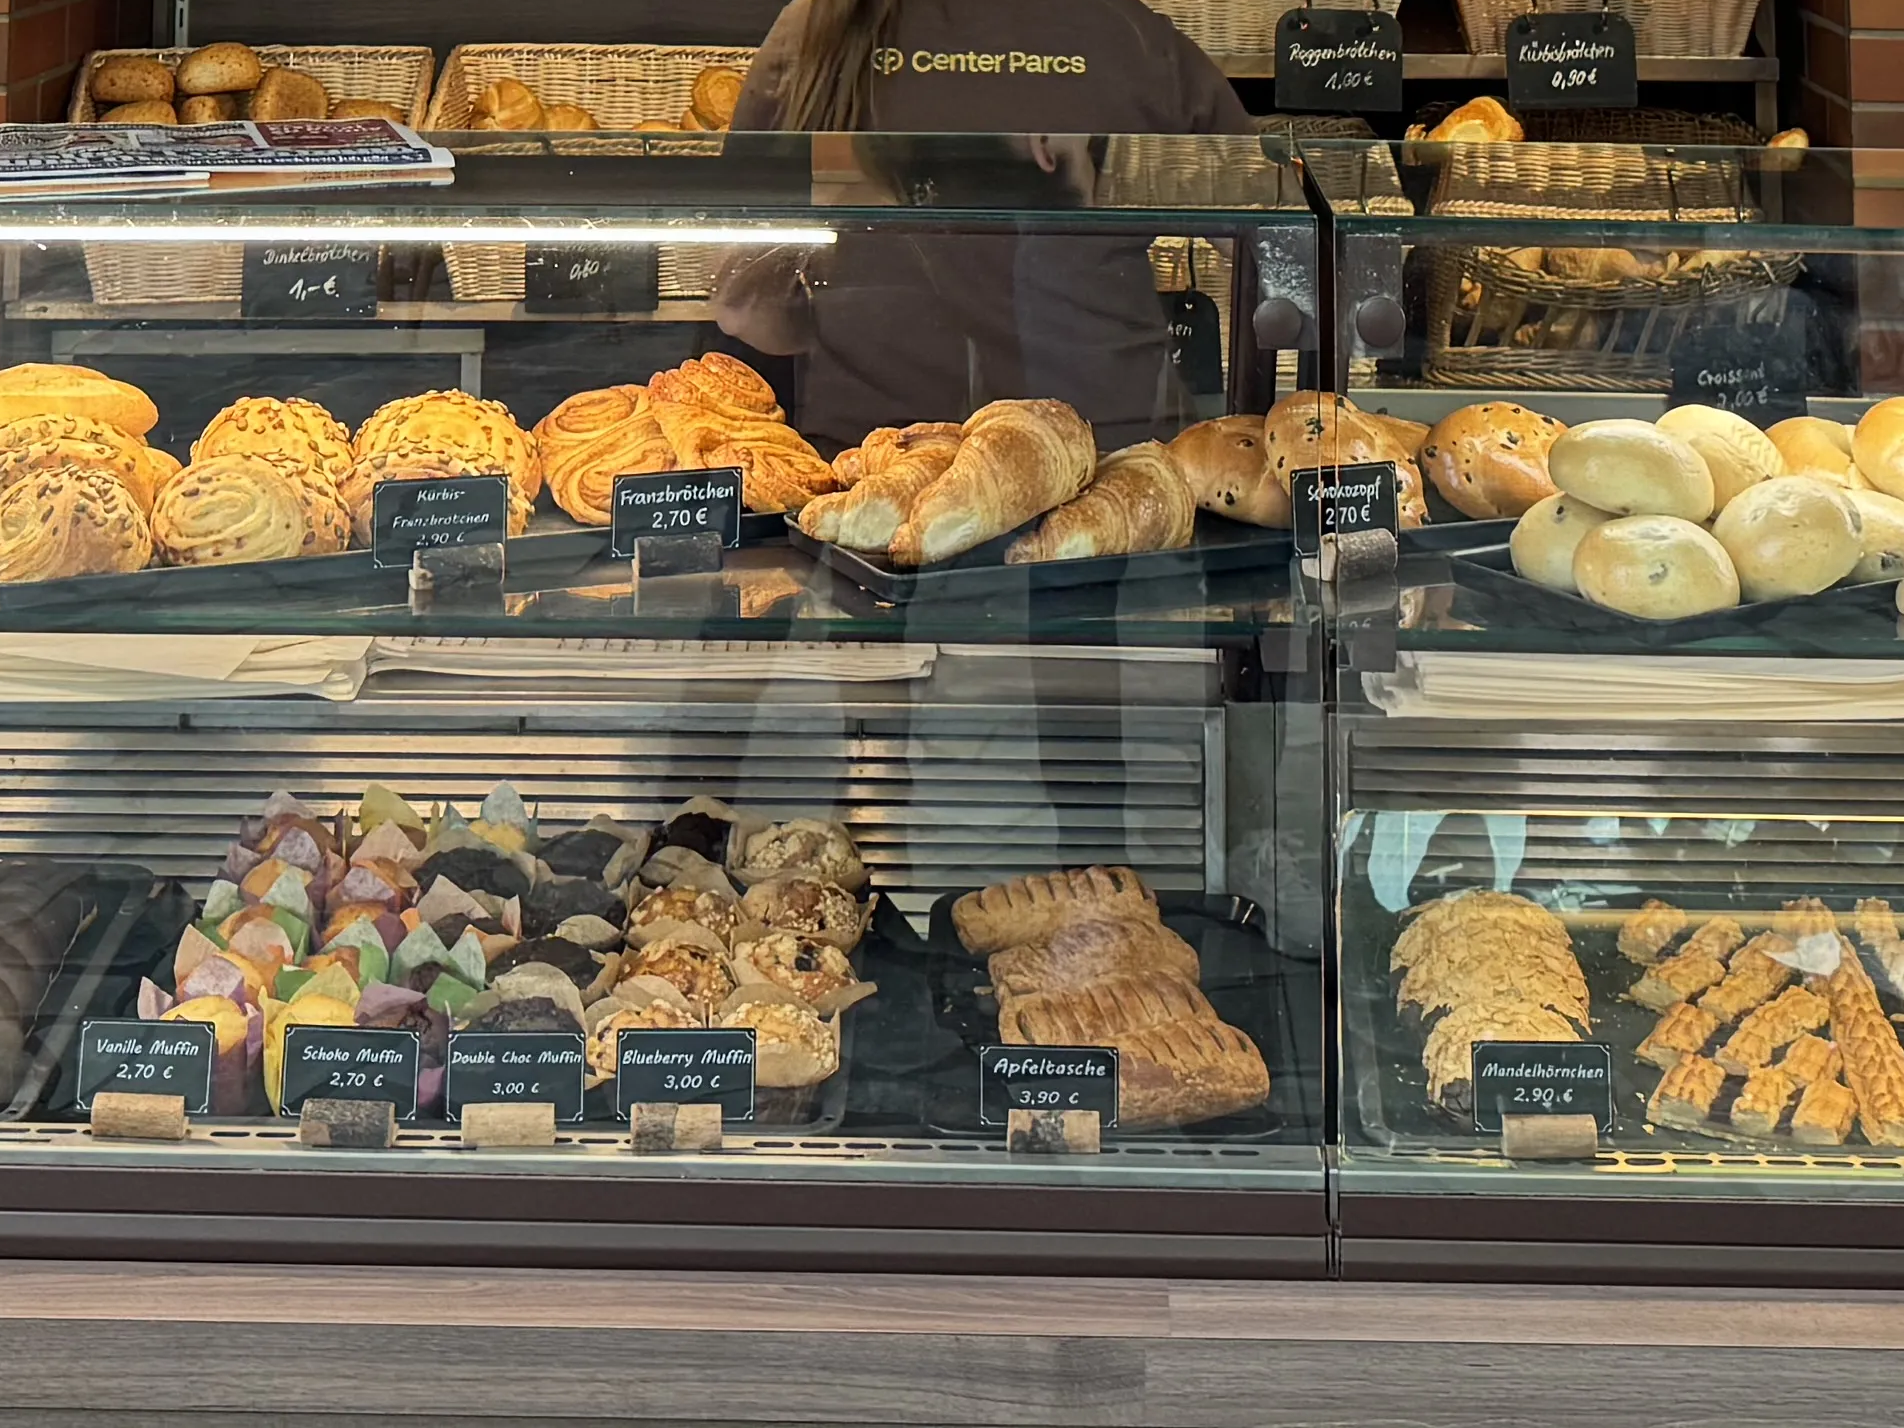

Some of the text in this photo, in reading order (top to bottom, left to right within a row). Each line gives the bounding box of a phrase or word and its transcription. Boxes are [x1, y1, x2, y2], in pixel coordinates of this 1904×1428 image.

[1289, 40, 1396, 67] Roggenbrötchen
[1519, 40, 1614, 62] Kürbisbrötchen
[912, 51, 1085, 74] Center Parcs
[263, 244, 369, 265] Dinkelbrötchen
[416, 488, 465, 503] Kürbis-
[620, 481, 734, 506] Franzbrötchen
[392, 513, 489, 528] Franzbrötchen
[652, 507, 708, 530] 2,70 €
[1361, 504, 1371, 522] €
[97, 1038, 199, 1057] Vanille Muffin
[302, 1045, 403, 1065] Schoko Muffin
[451, 1051, 582, 1065] Double Choc Muffin
[622, 1049, 753, 1068] Blueberry Muffin
[116, 1064, 154, 1080] 2,70
[993, 1058, 1106, 1078] Apfeltasche
[1482, 1063, 1604, 1079] Mandelhörnchen
[329, 1072, 366, 1088] 2,70
